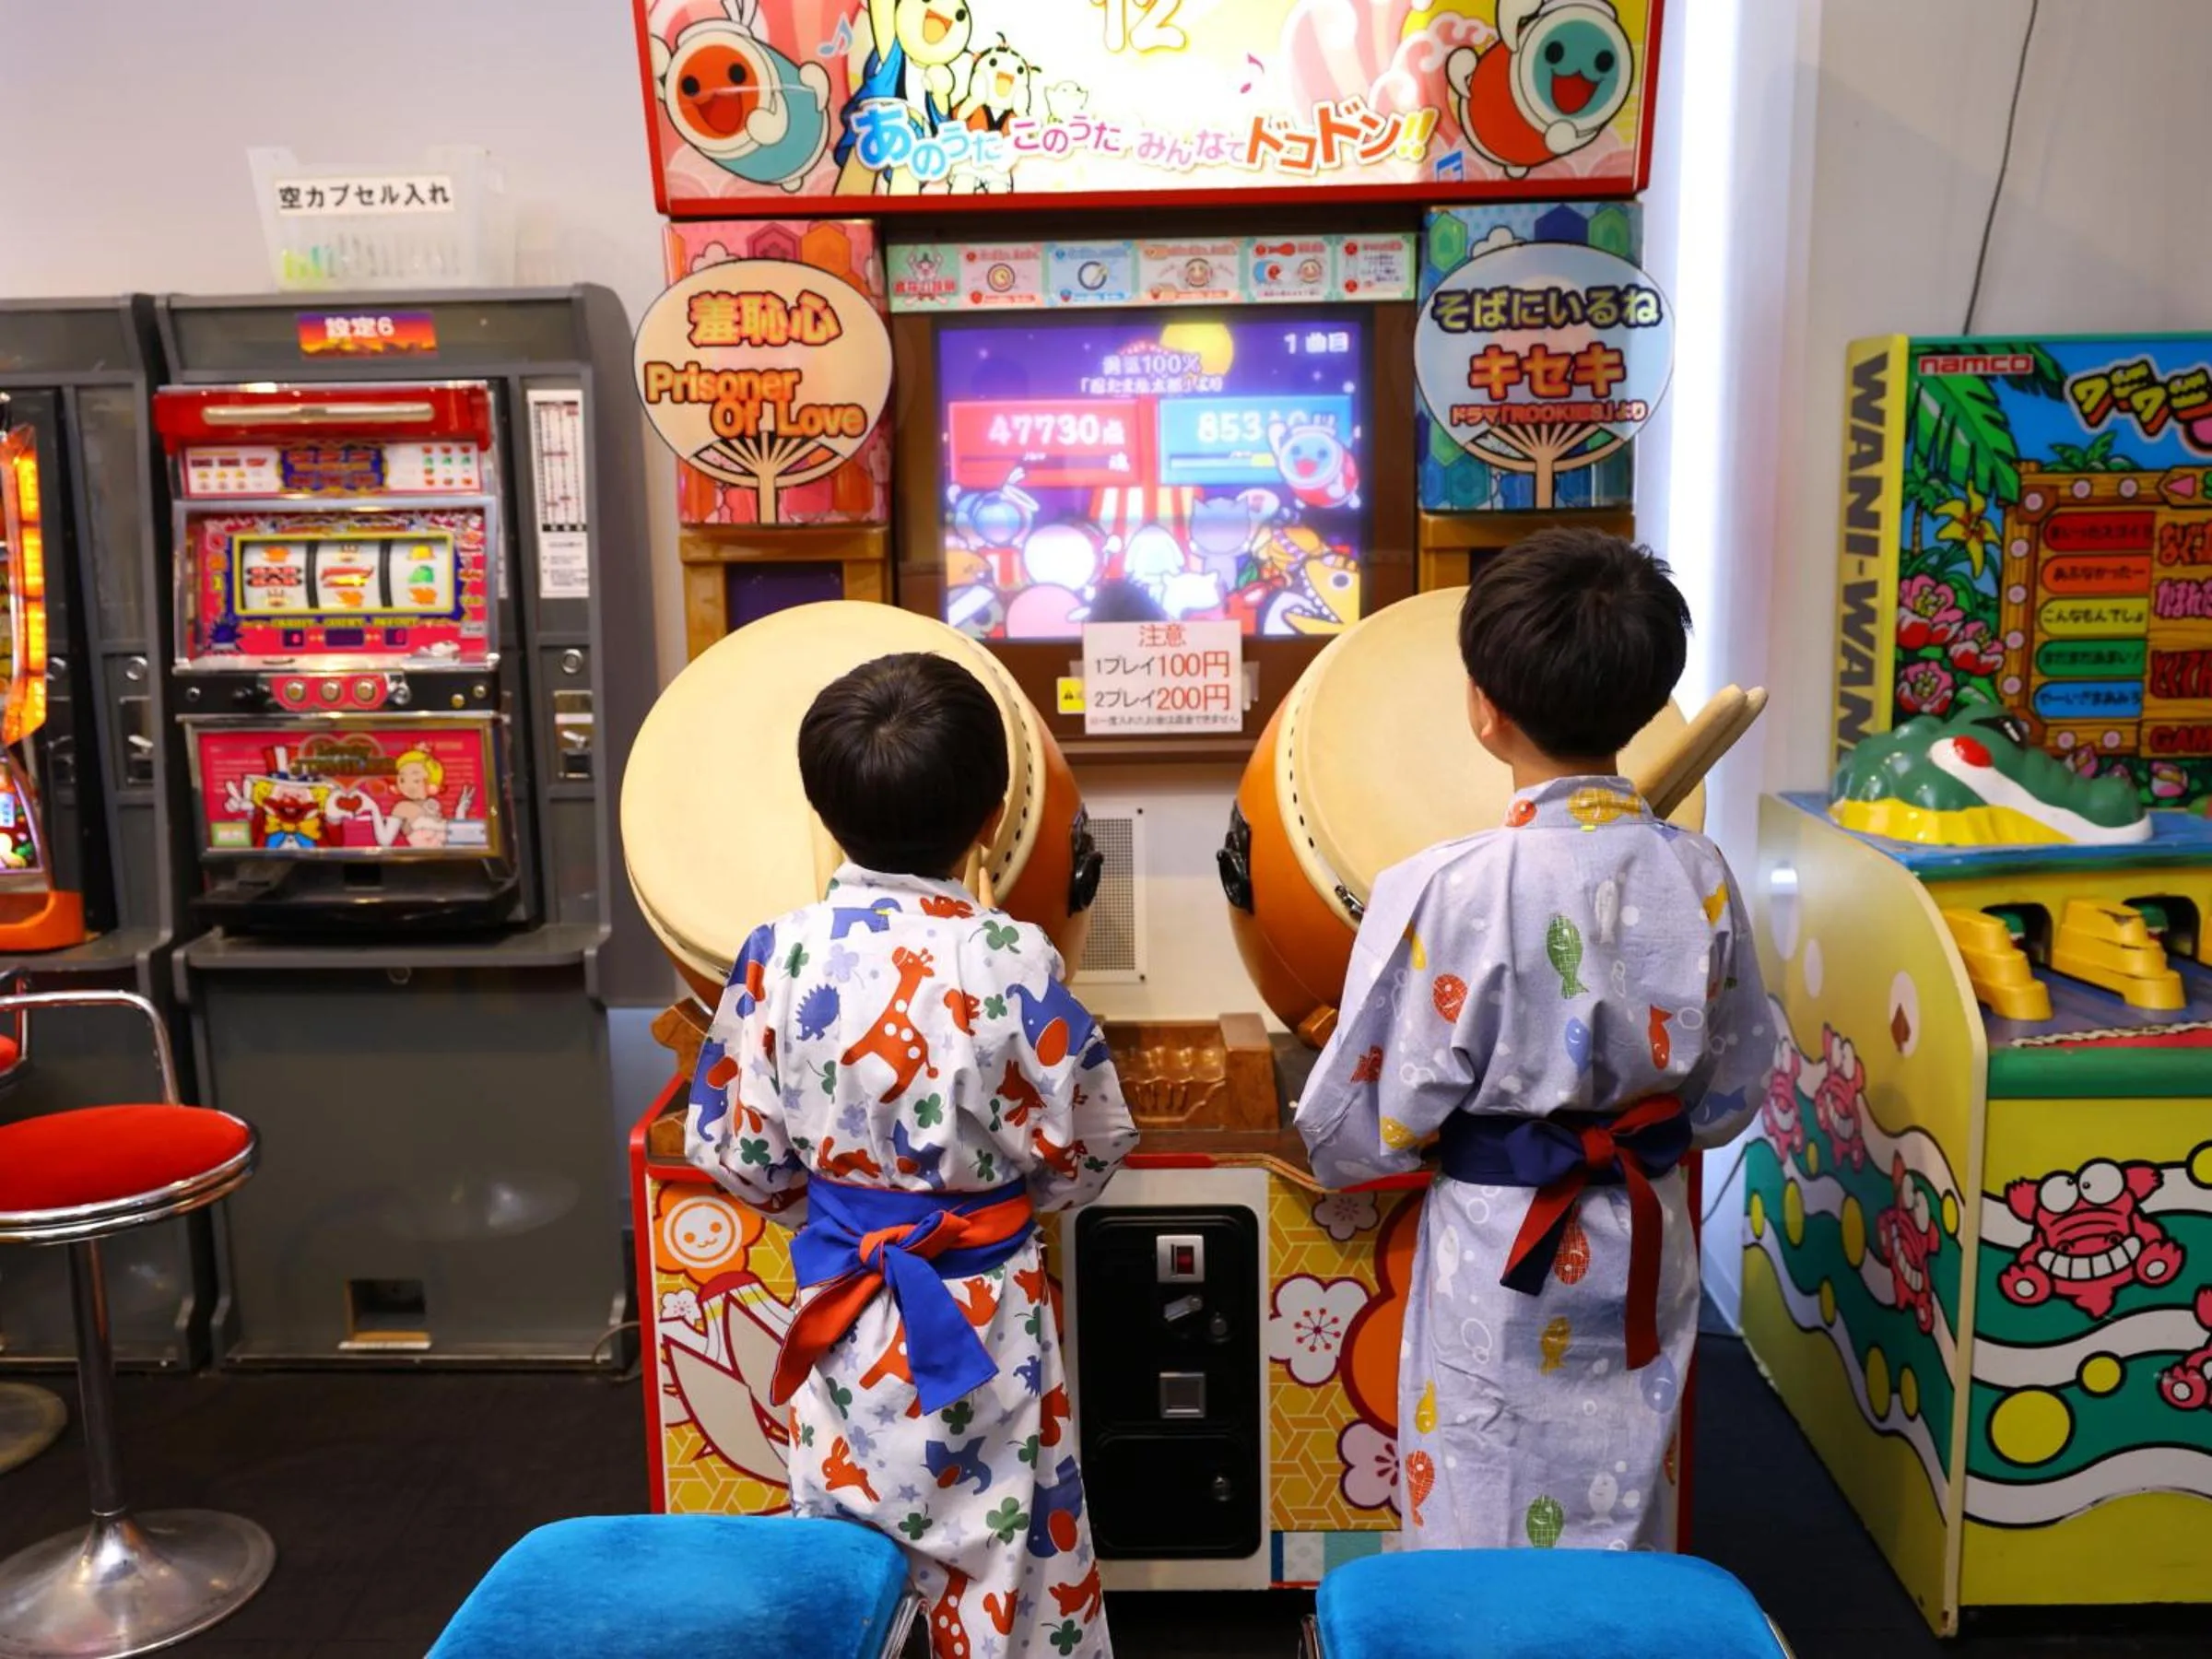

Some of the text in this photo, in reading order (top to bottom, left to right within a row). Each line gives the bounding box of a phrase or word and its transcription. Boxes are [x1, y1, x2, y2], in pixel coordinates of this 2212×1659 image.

[853, 103, 1003, 176] あのうた
[1015, 116, 1121, 153] このうた
[279, 182, 451, 209] 空カプセル入れ
[688, 289, 842, 347] 羞恥心
[1431, 284, 1663, 332] そばにいるね
[644, 361, 802, 404] Prisoner
[1468, 341, 1626, 400] キセキ
[1920, 355, 2032, 373] namco
[710, 397, 867, 438] Of Love
[1837, 351, 1888, 764] WANI-WAN
[1138, 623, 1187, 648] 注意
